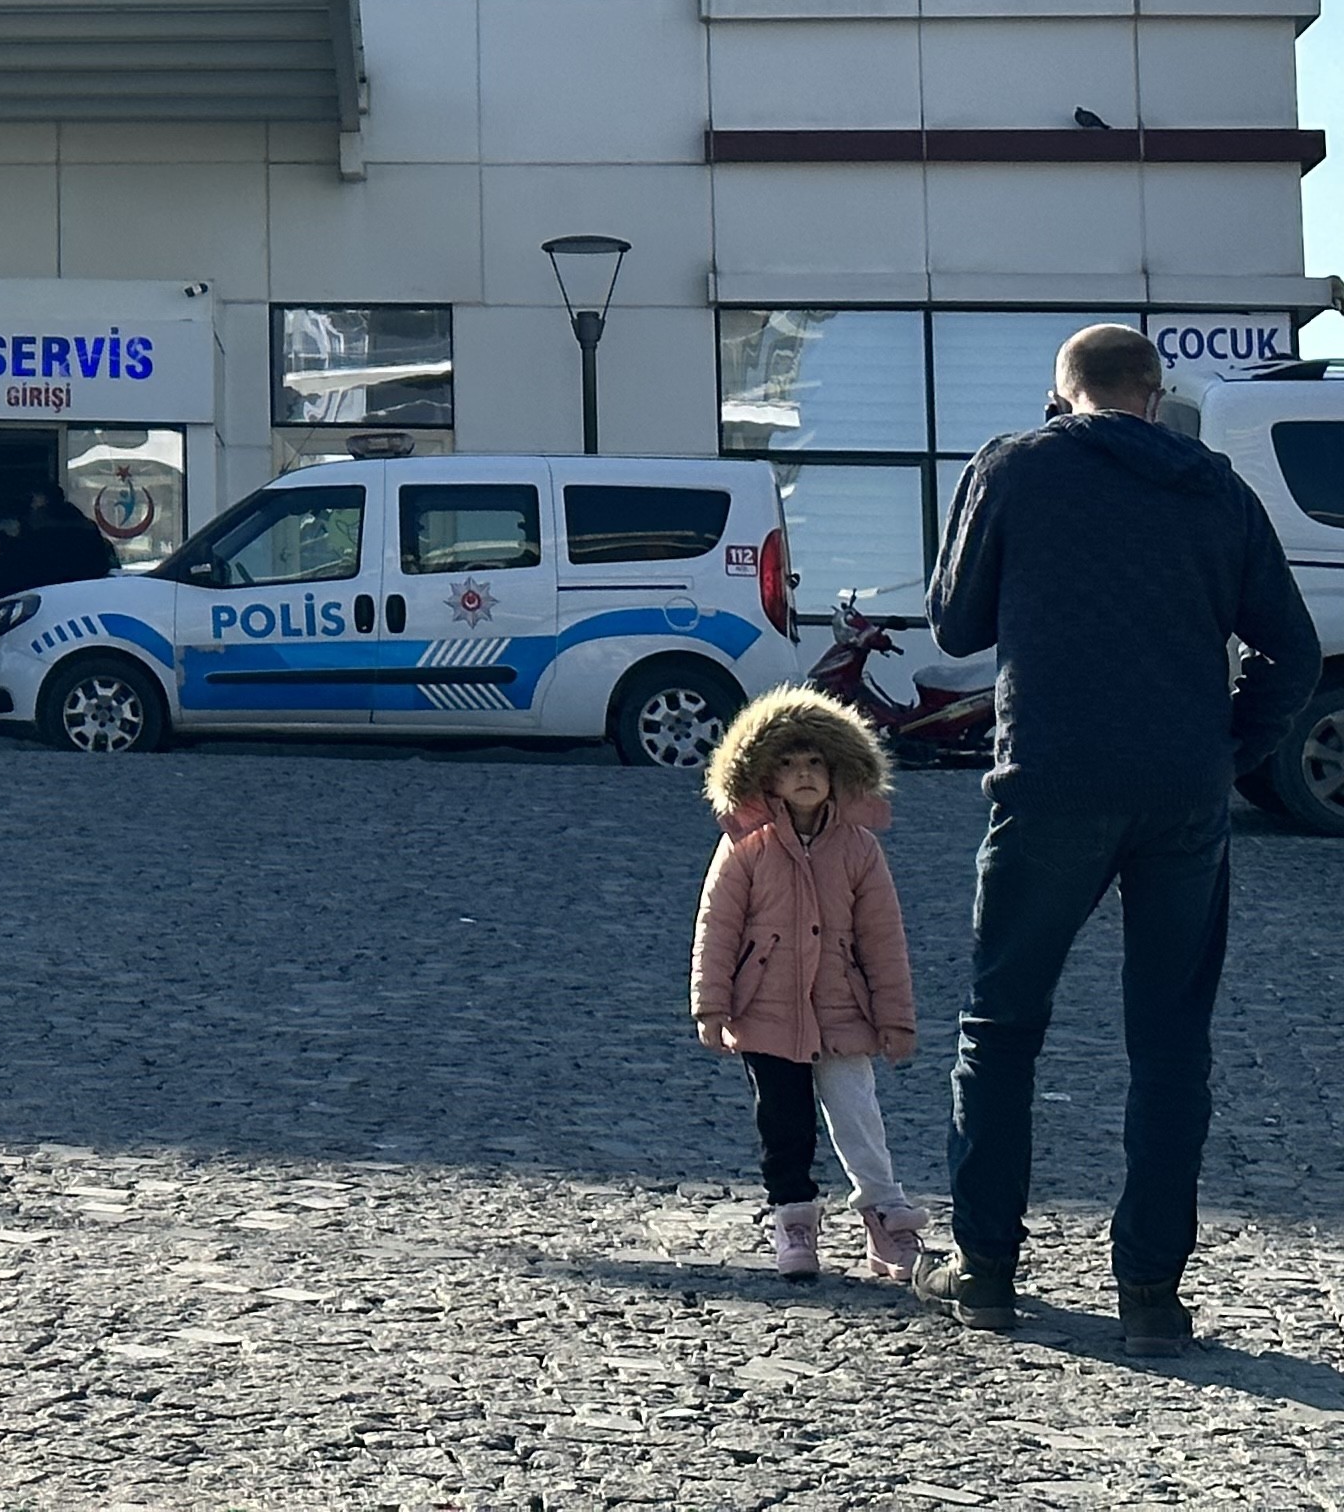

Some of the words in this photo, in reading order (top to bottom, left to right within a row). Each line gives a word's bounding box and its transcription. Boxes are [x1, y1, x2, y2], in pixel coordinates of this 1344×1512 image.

[1156, 327, 1279, 369] ÇOCUK
[6, 382, 72, 413] GİRİŞİ
[730, 548, 754, 564] 112
[212, 592, 345, 638] POLİS
